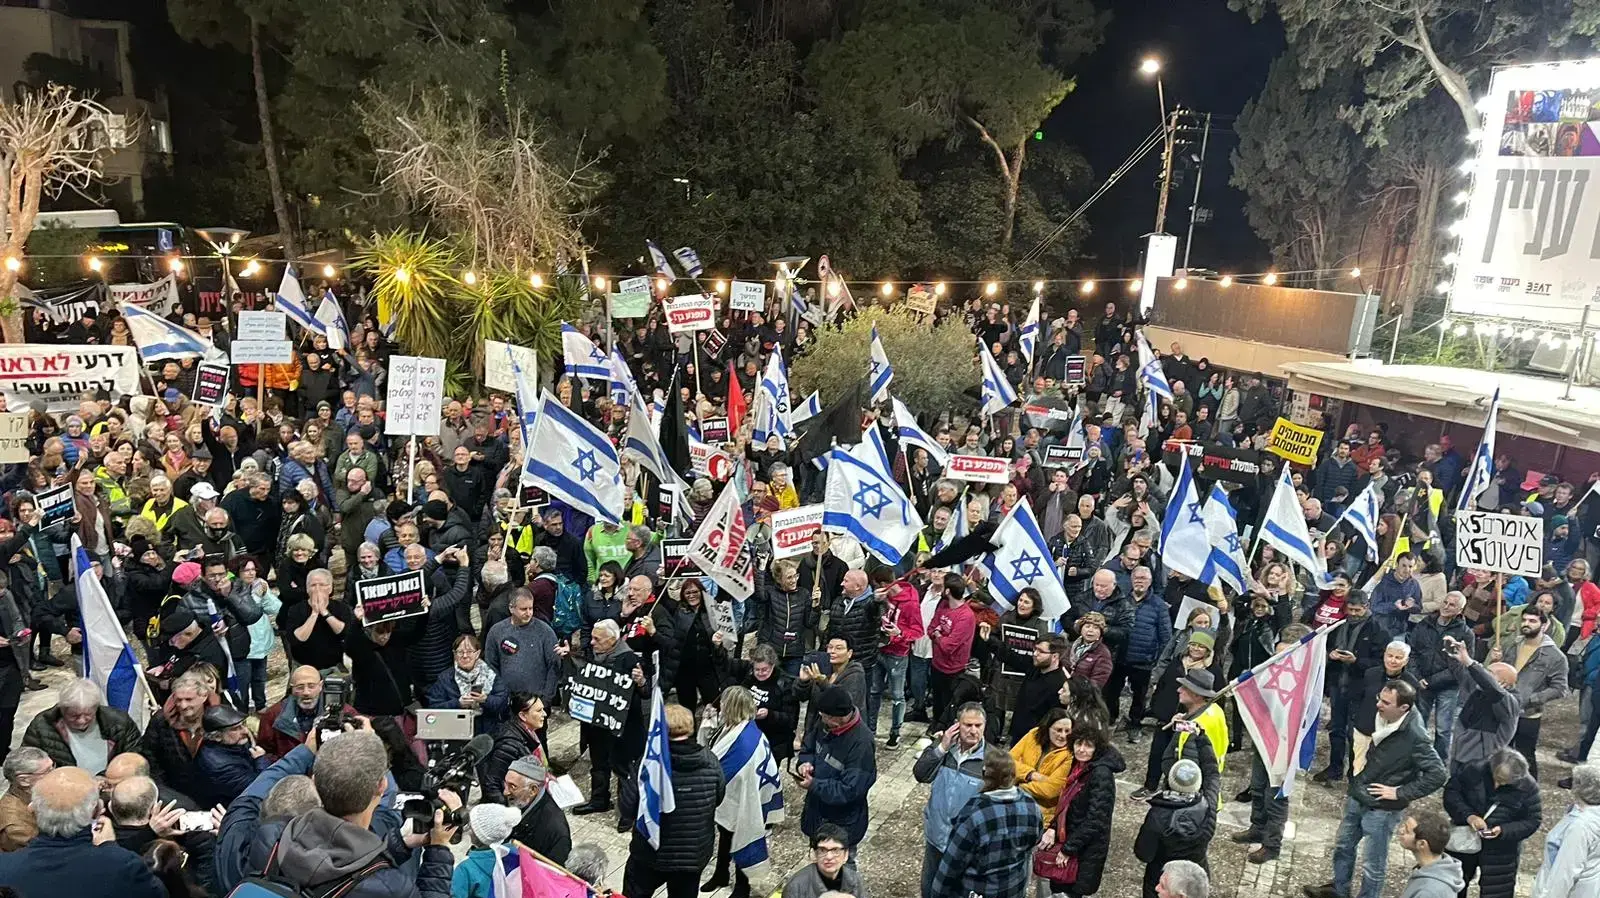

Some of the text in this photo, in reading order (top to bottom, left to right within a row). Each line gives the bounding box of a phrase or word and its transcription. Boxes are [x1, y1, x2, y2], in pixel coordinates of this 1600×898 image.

[1481, 169, 1591, 263] עניין
[0, 352, 124, 372] דרעי לא ראו
[12, 377, 115, 395] להיות שר!
[1484, 540, 1541, 573] פשוט
[580, 663, 633, 689] לא ימין,
[564, 676, 628, 711] לא שמאל,
[595, 713, 622, 730] ישר.
